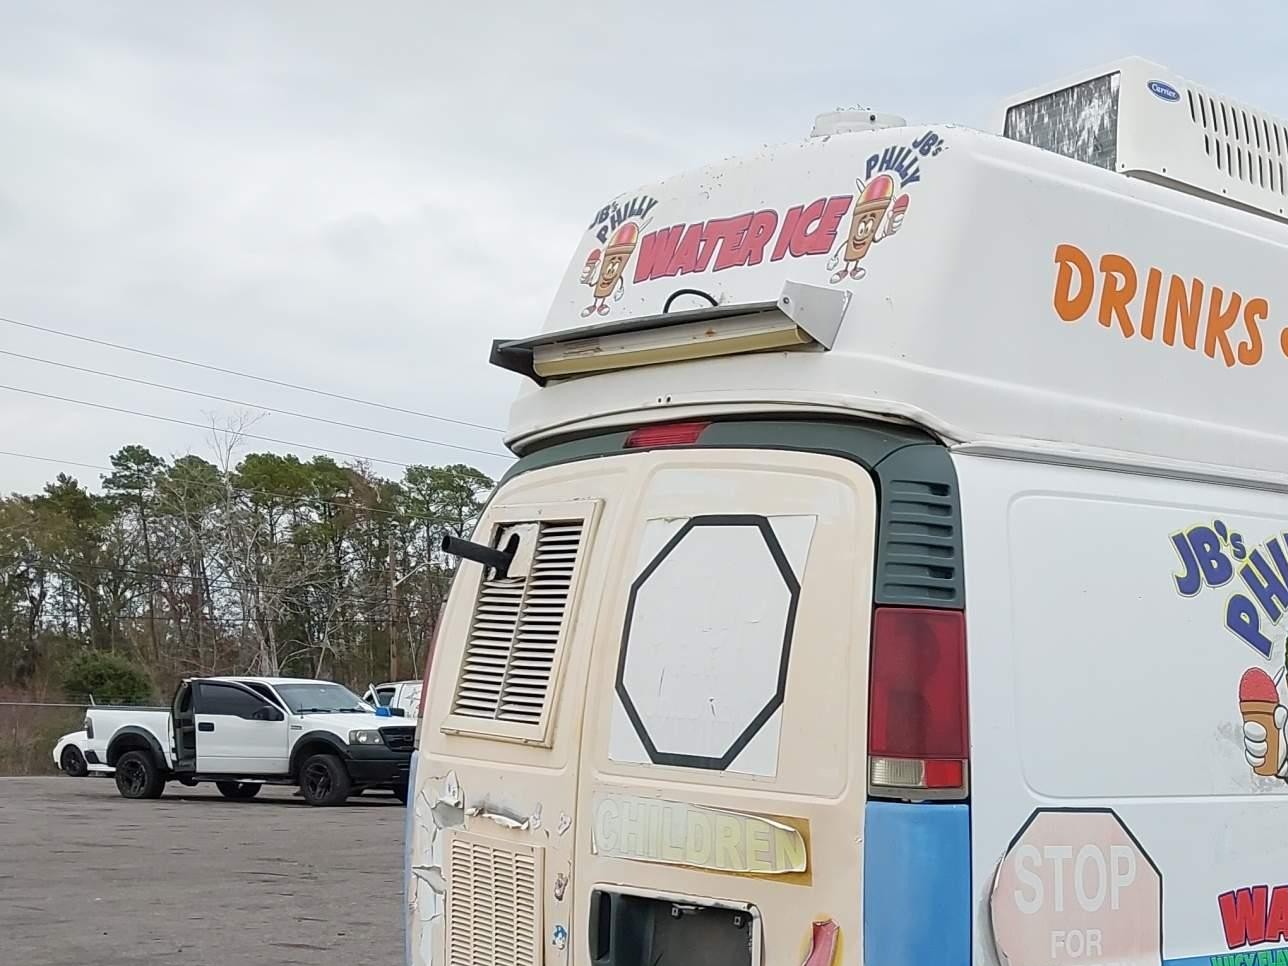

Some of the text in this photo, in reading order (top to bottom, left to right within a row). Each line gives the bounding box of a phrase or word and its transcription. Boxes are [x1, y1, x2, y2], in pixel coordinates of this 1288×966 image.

[865, 145, 920, 189] PHILLY
[596, 195, 658, 244] PHILLY
[633, 194, 853, 284] WATER ICE
[1053, 243, 1269, 368] DRINKS
[1170, 519, 1247, 598] JB's
[597, 797, 805, 872] CHILDREN
[1013, 843, 1138, 916] STOP
[1050, 929, 1104, 959] FOR
